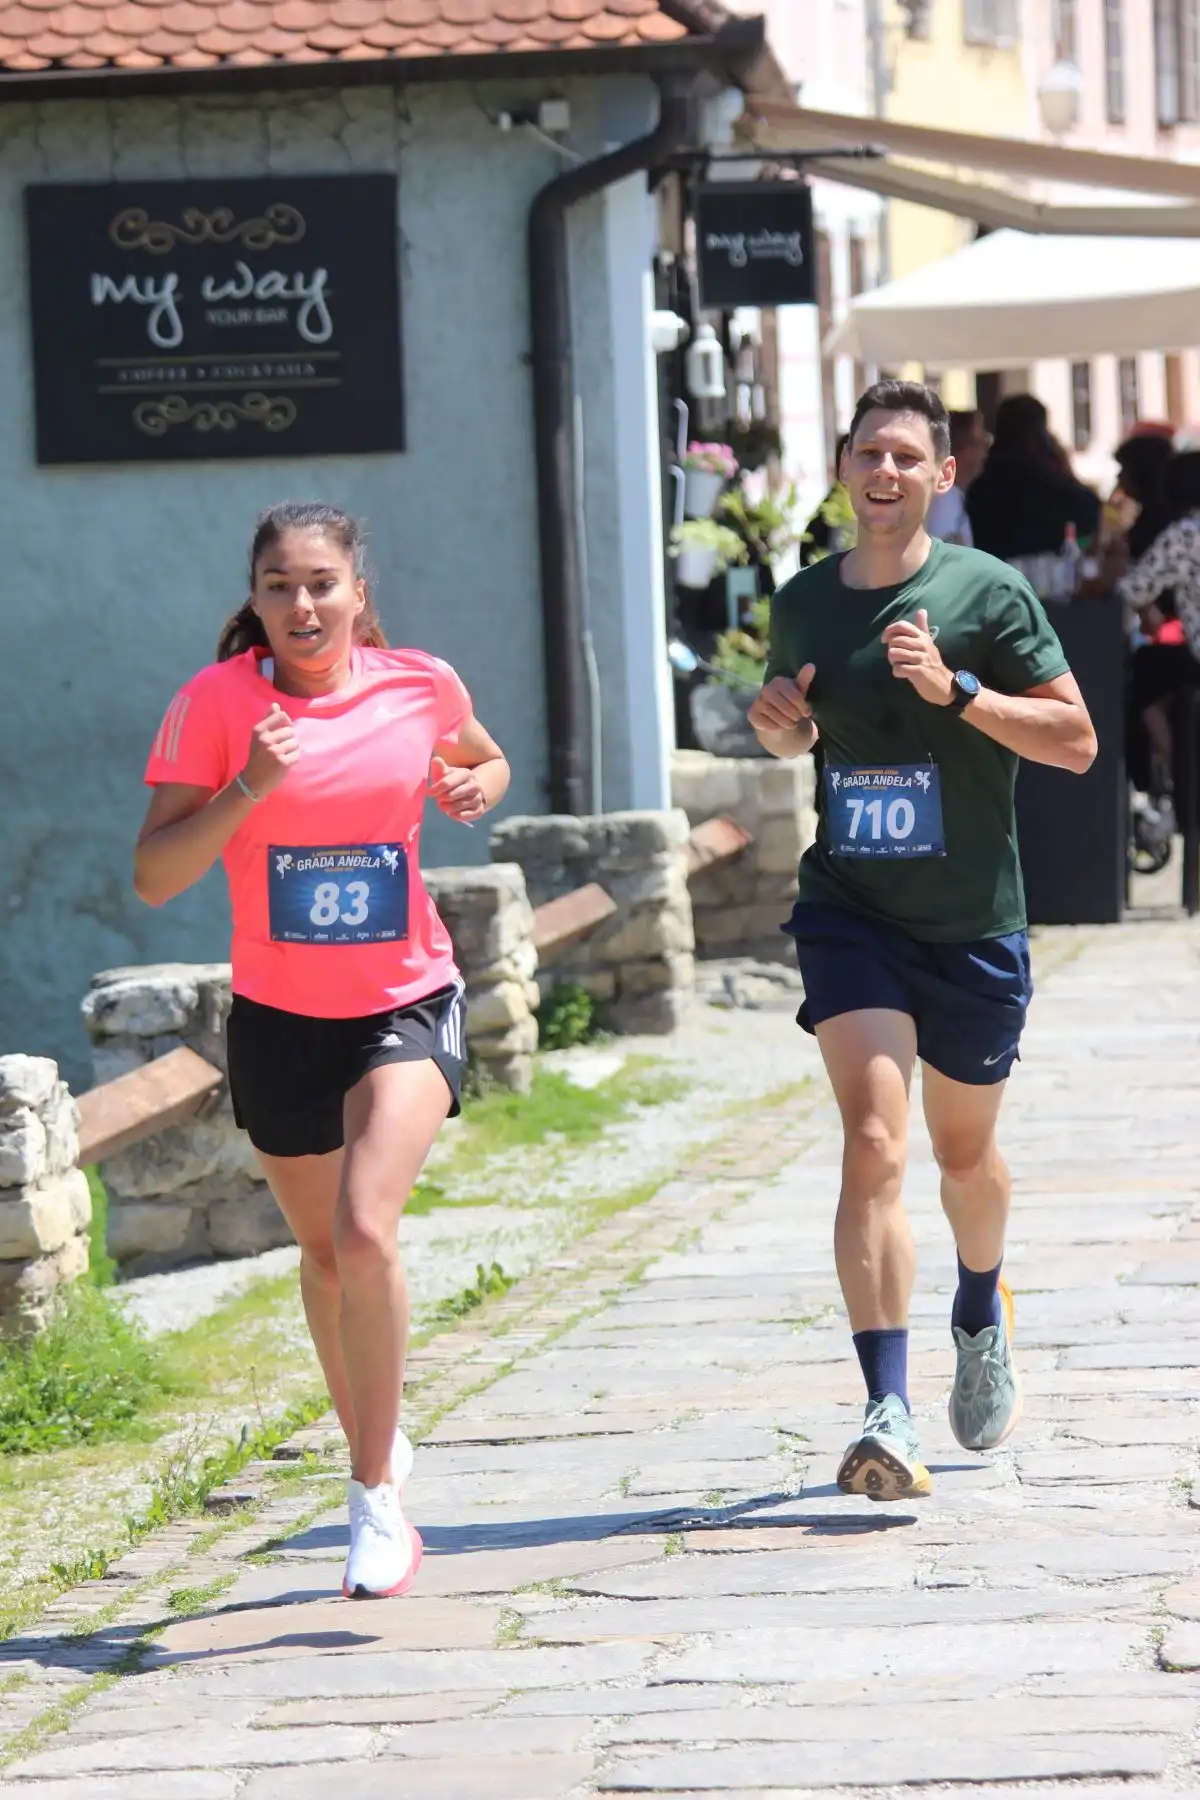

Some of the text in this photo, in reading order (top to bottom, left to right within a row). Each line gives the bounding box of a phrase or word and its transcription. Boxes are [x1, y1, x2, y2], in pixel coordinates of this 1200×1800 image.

[91, 260, 333, 348] my way
[843, 775, 870, 788] GRADA
[846, 798, 916, 839] 710
[297, 856, 335, 871] GRADA
[310, 881, 370, 926] 83
